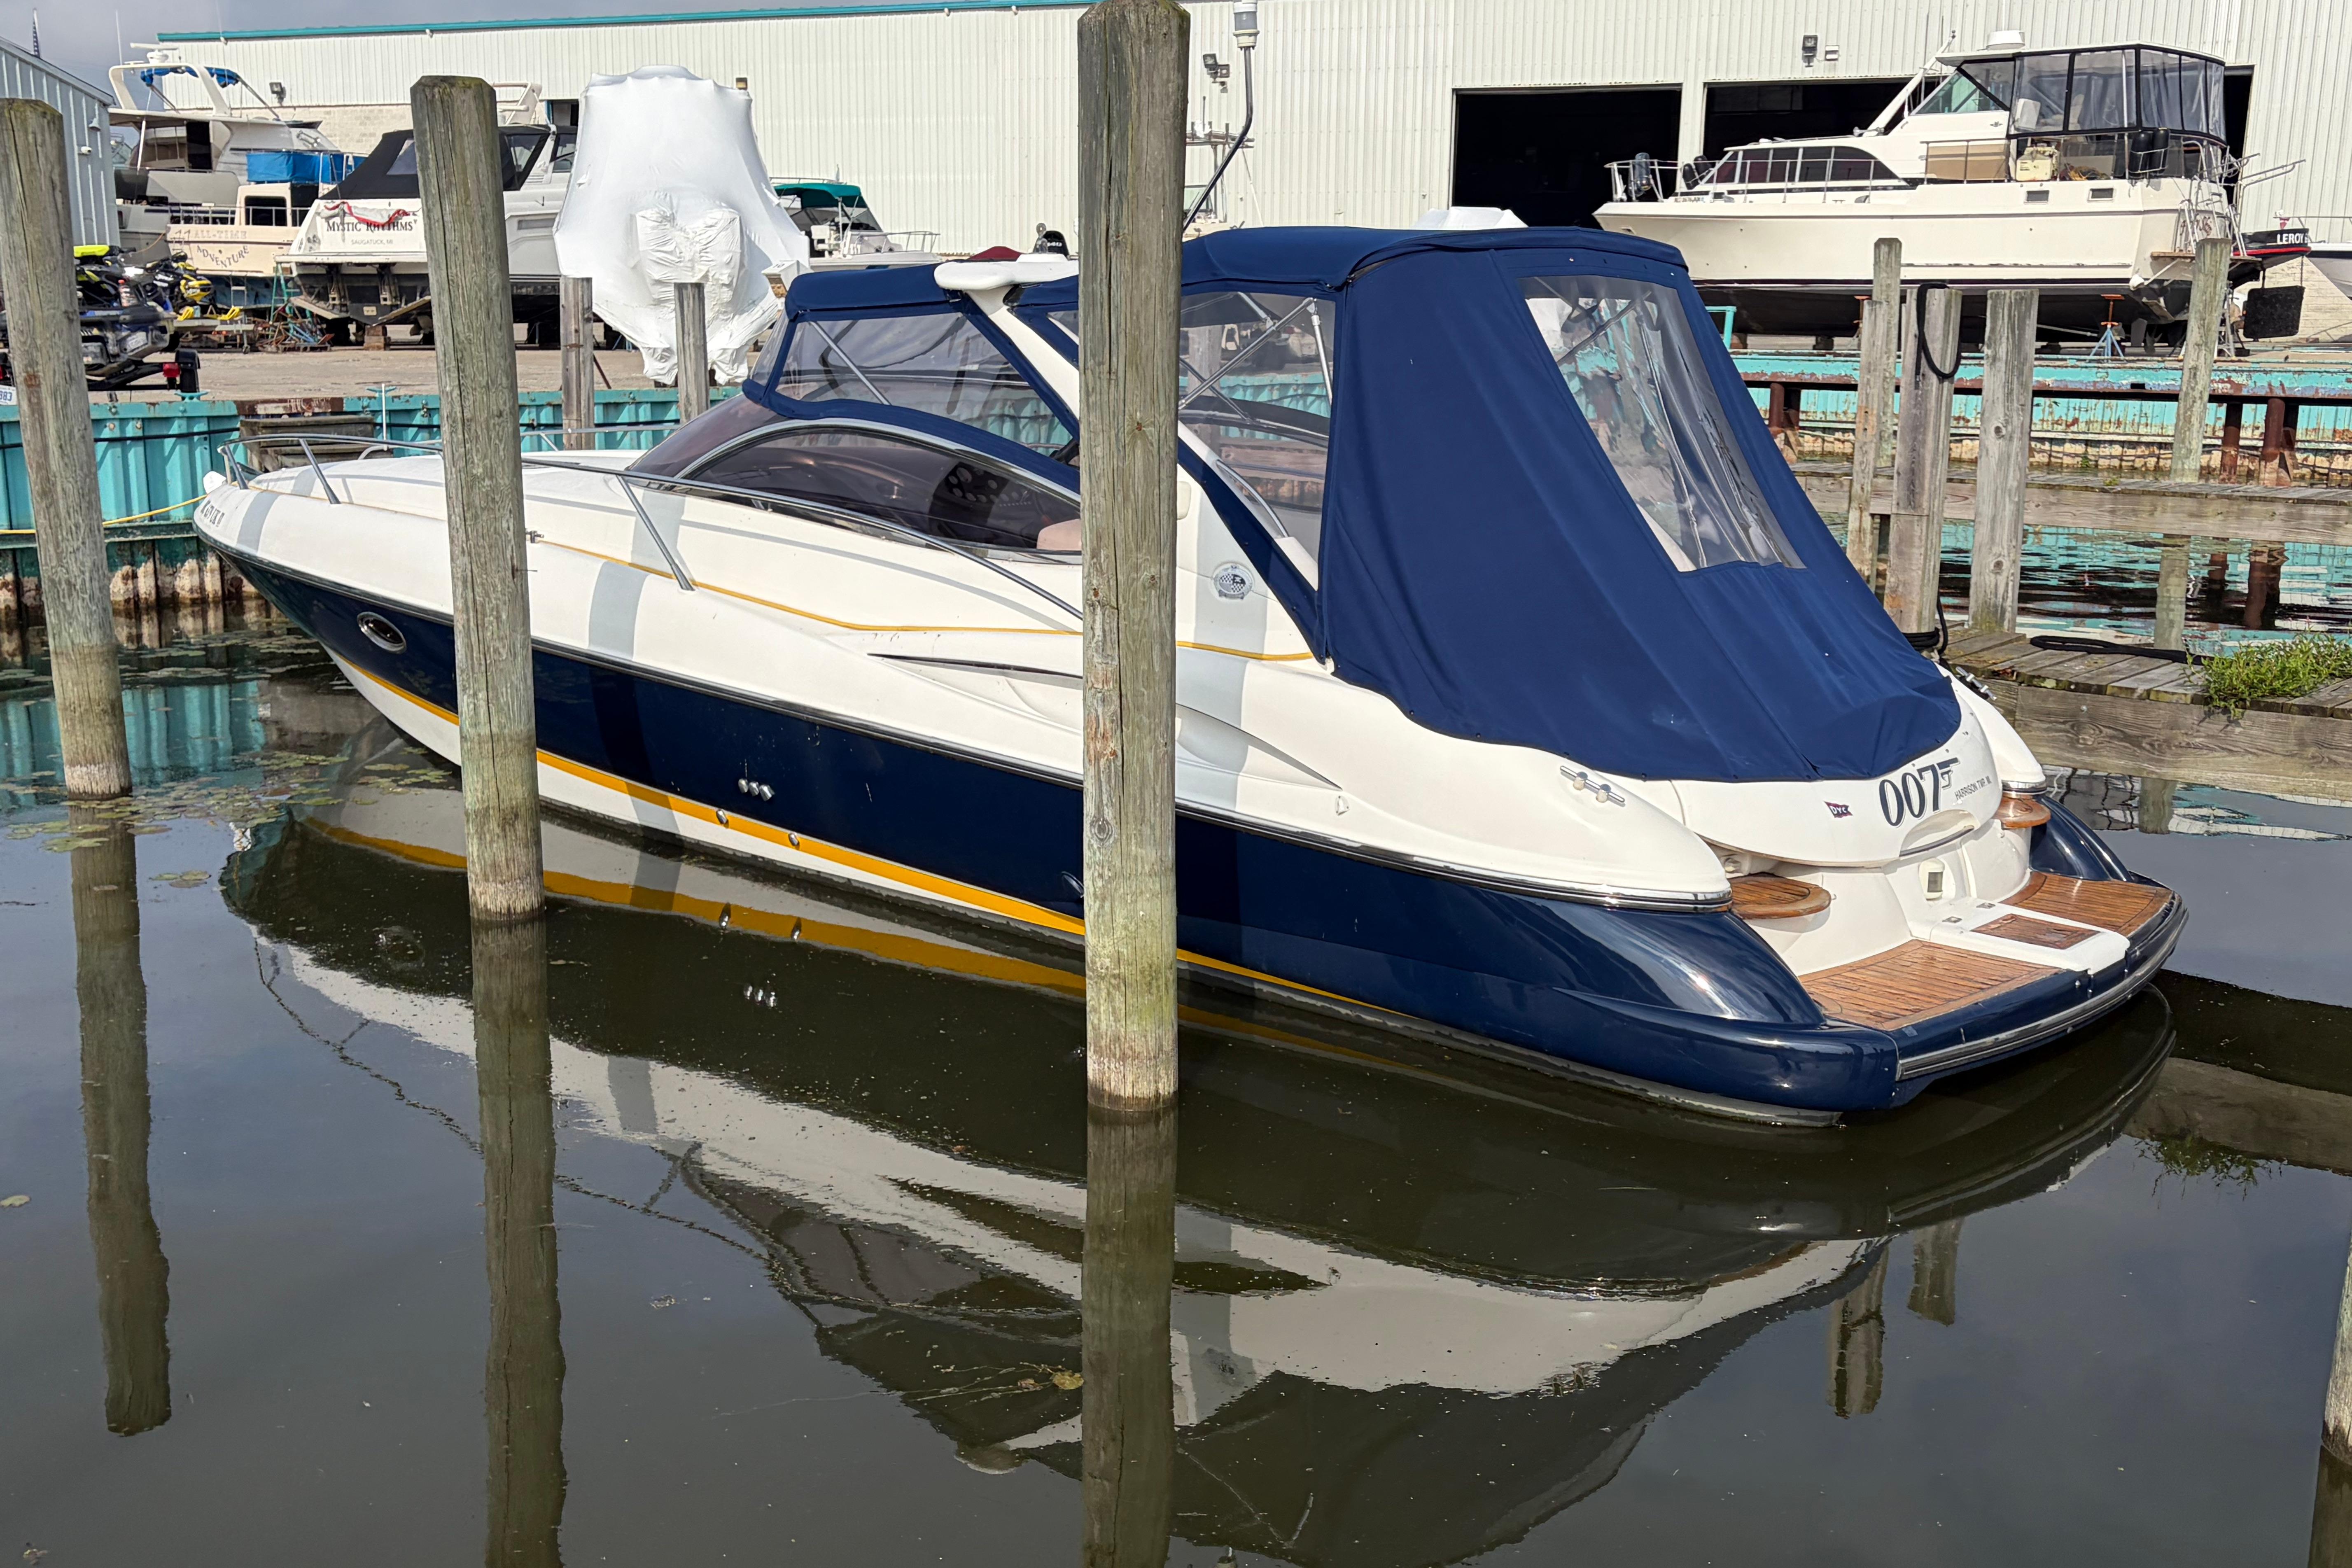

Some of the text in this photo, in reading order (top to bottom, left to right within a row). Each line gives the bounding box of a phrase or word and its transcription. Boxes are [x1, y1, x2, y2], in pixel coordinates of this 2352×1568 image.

[327, 220, 362, 232] MYSTIC
[2277, 233, 2304, 245] LEROY
[197, 245, 250, 268] ADVENTURE
[1879, 762, 1942, 827] 007
[1829, 805, 1847, 814] DYC
